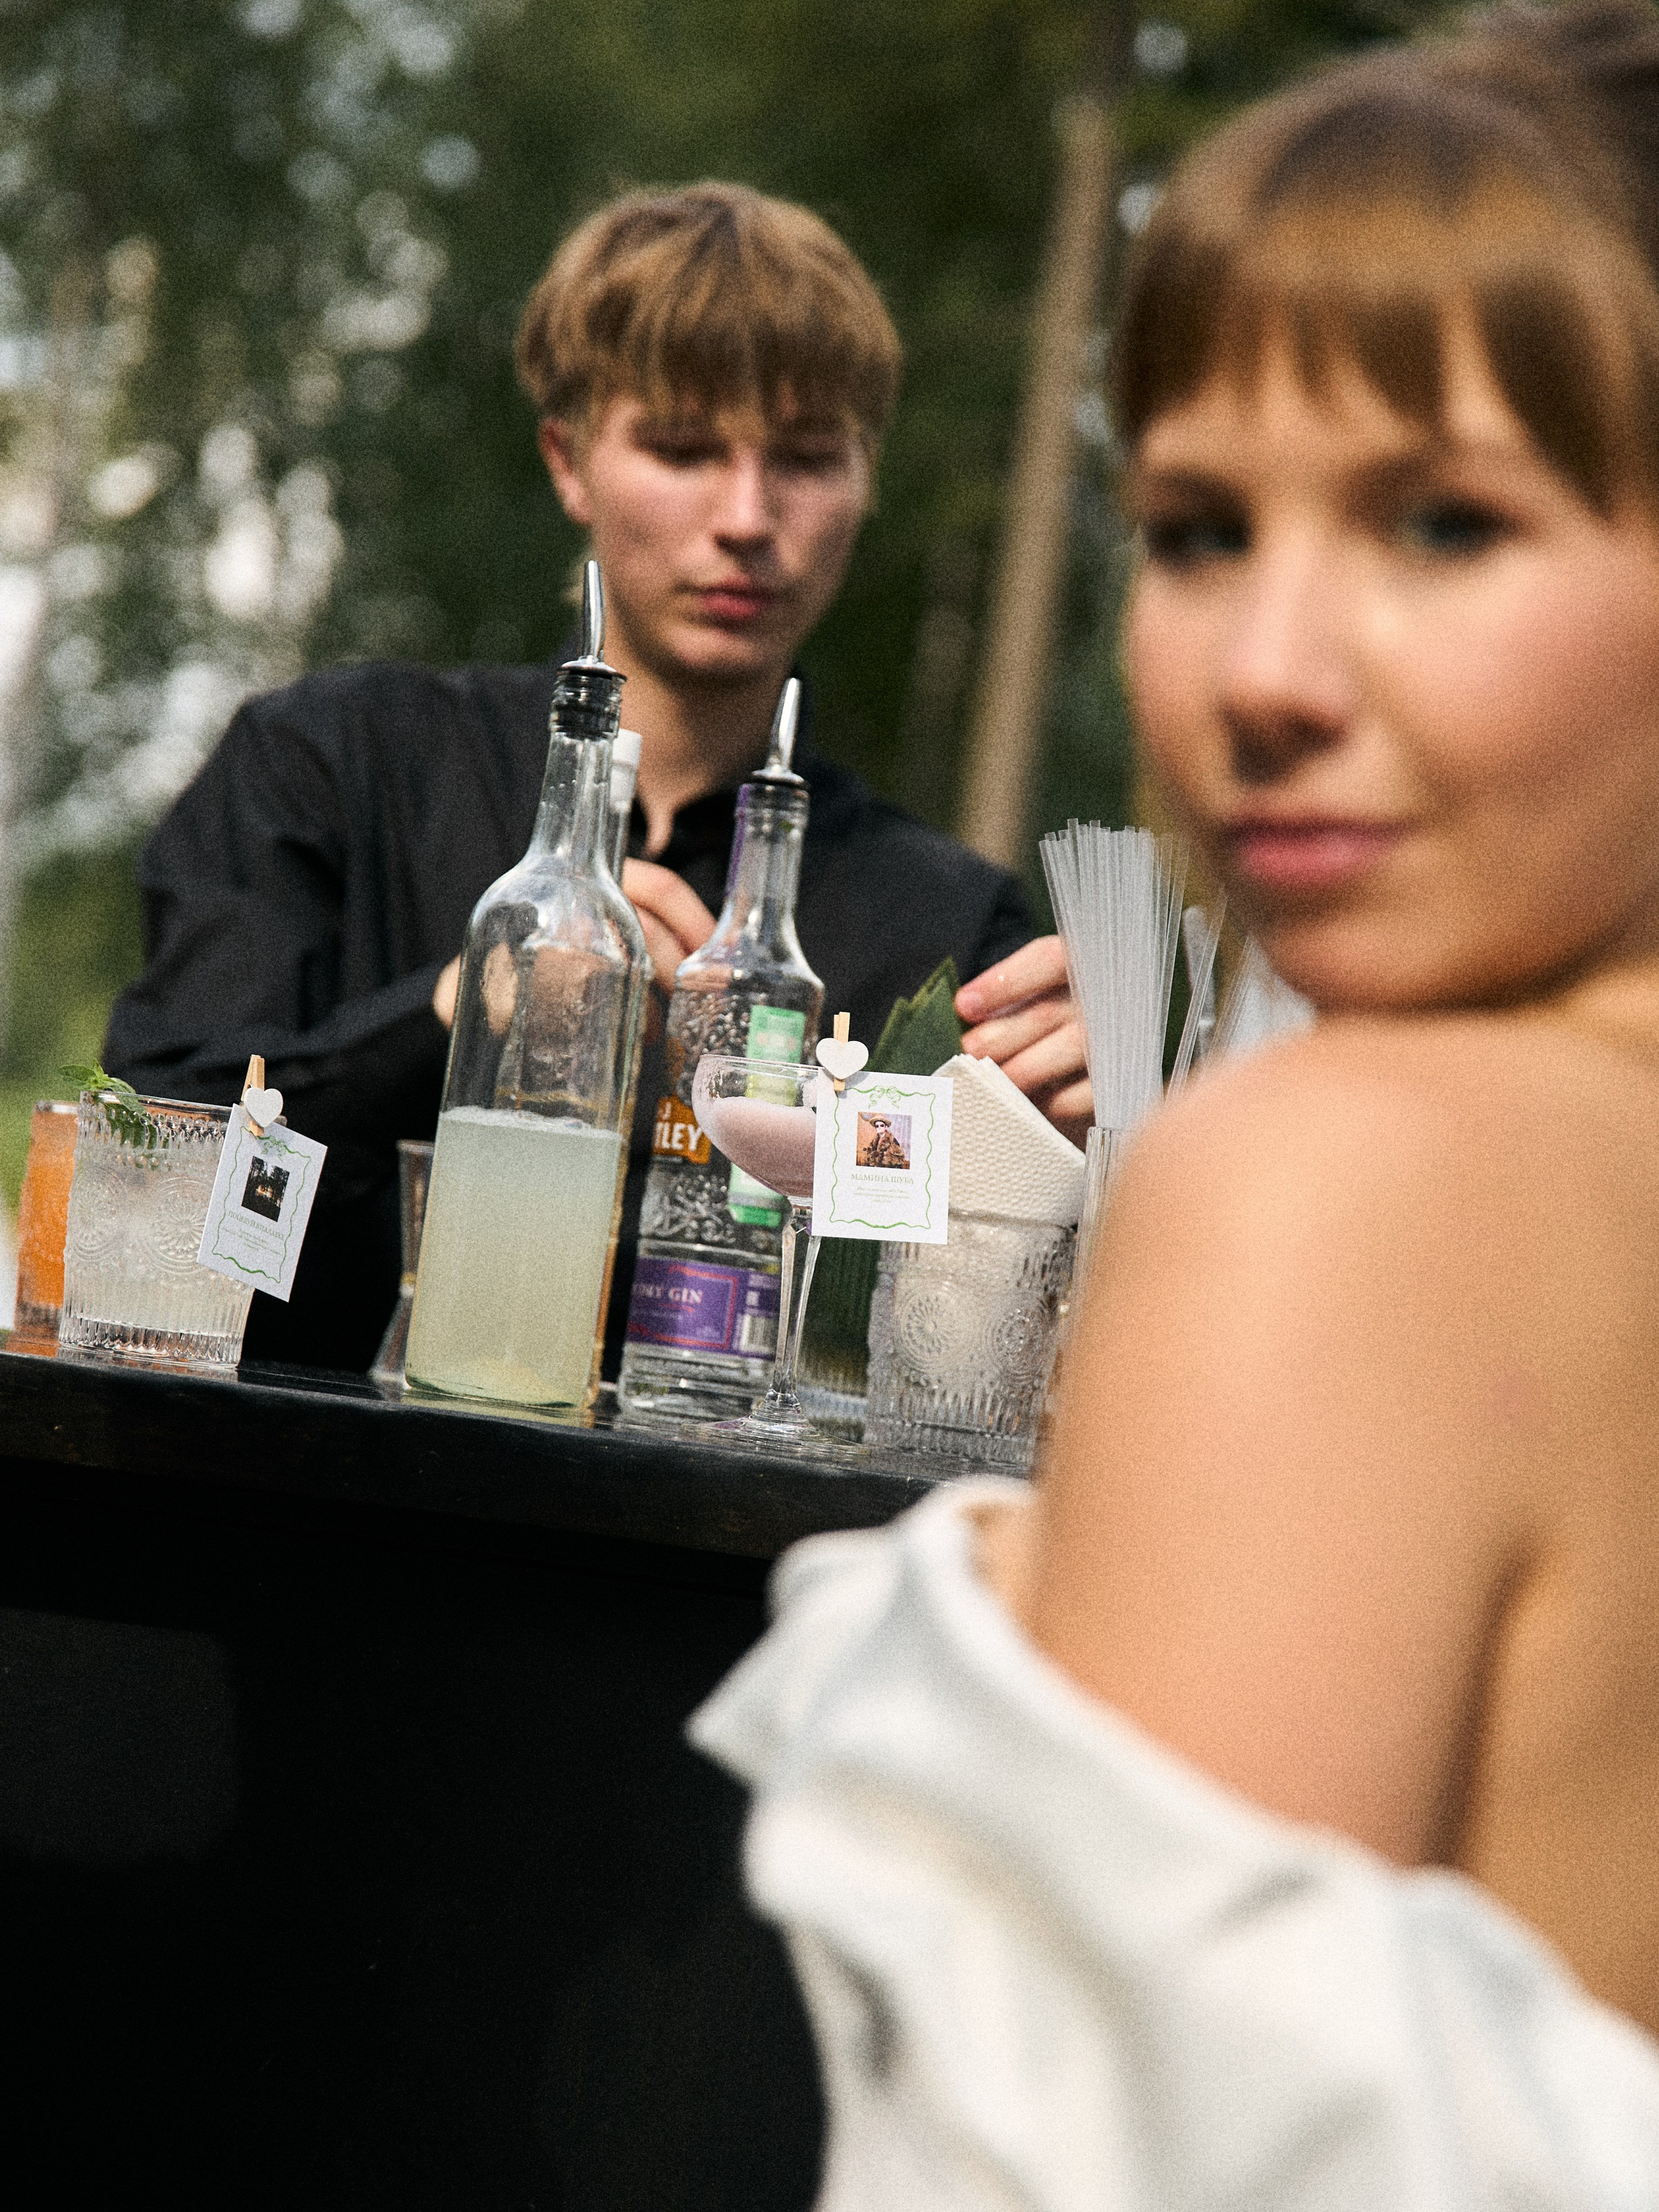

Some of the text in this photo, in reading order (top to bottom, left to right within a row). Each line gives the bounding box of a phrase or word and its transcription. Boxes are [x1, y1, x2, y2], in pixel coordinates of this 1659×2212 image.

[851, 1173, 914, 1184] МАМИНА ШУБА
[228, 1210, 256, 1228] ПОЦЕЛУЙ
[667, 1287, 704, 1305] GIN
